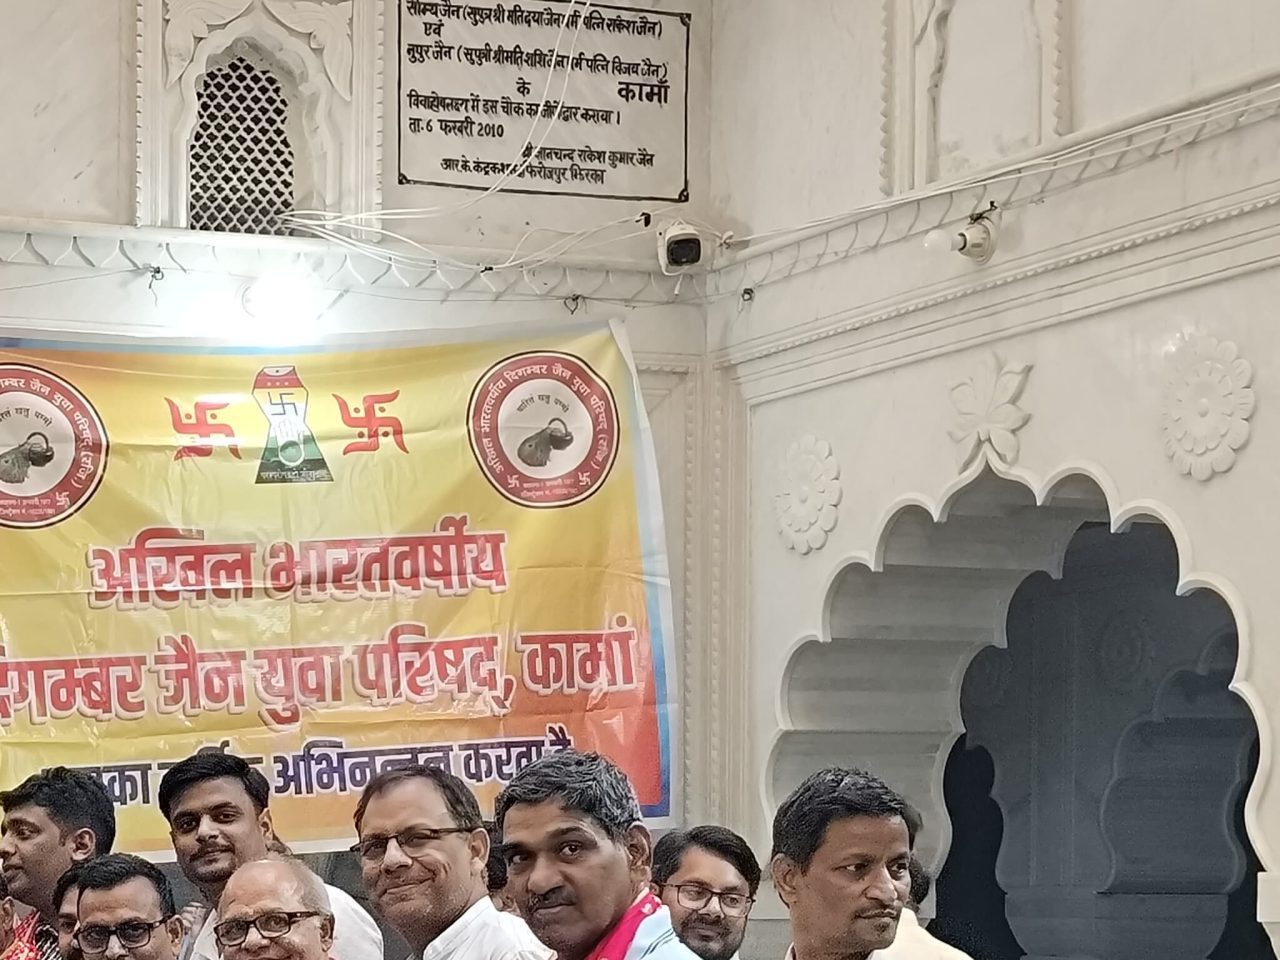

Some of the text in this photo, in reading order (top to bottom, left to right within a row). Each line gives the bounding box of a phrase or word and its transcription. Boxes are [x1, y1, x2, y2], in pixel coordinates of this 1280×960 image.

[422, 19, 444, 37] एवं
[432, 40, 455, 60] जैन
[515, 77, 531, 97] के
[470, 92, 482, 114] में
[482, 99, 499, 115] इस
[501, 95, 524, 117] चौक
[477, 122, 505, 138] 2010
[577, 145, 607, 164] राकेश
[608, 151, 637, 169] कुमार
[636, 148, 655, 168] जैन
[30, 378, 51, 396] जैन
[53, 391, 74, 411] युवा
[482, 437, 505, 474] अखिल
[552, 363, 572, 380] जैन
[571, 375, 590, 396] युवा
[89, 515, 509, 604] अखिल भारतवर्षीय
[153, 633, 247, 711] जैन
[252, 645, 344, 728] युवा
[519, 614, 636, 692] कामां
